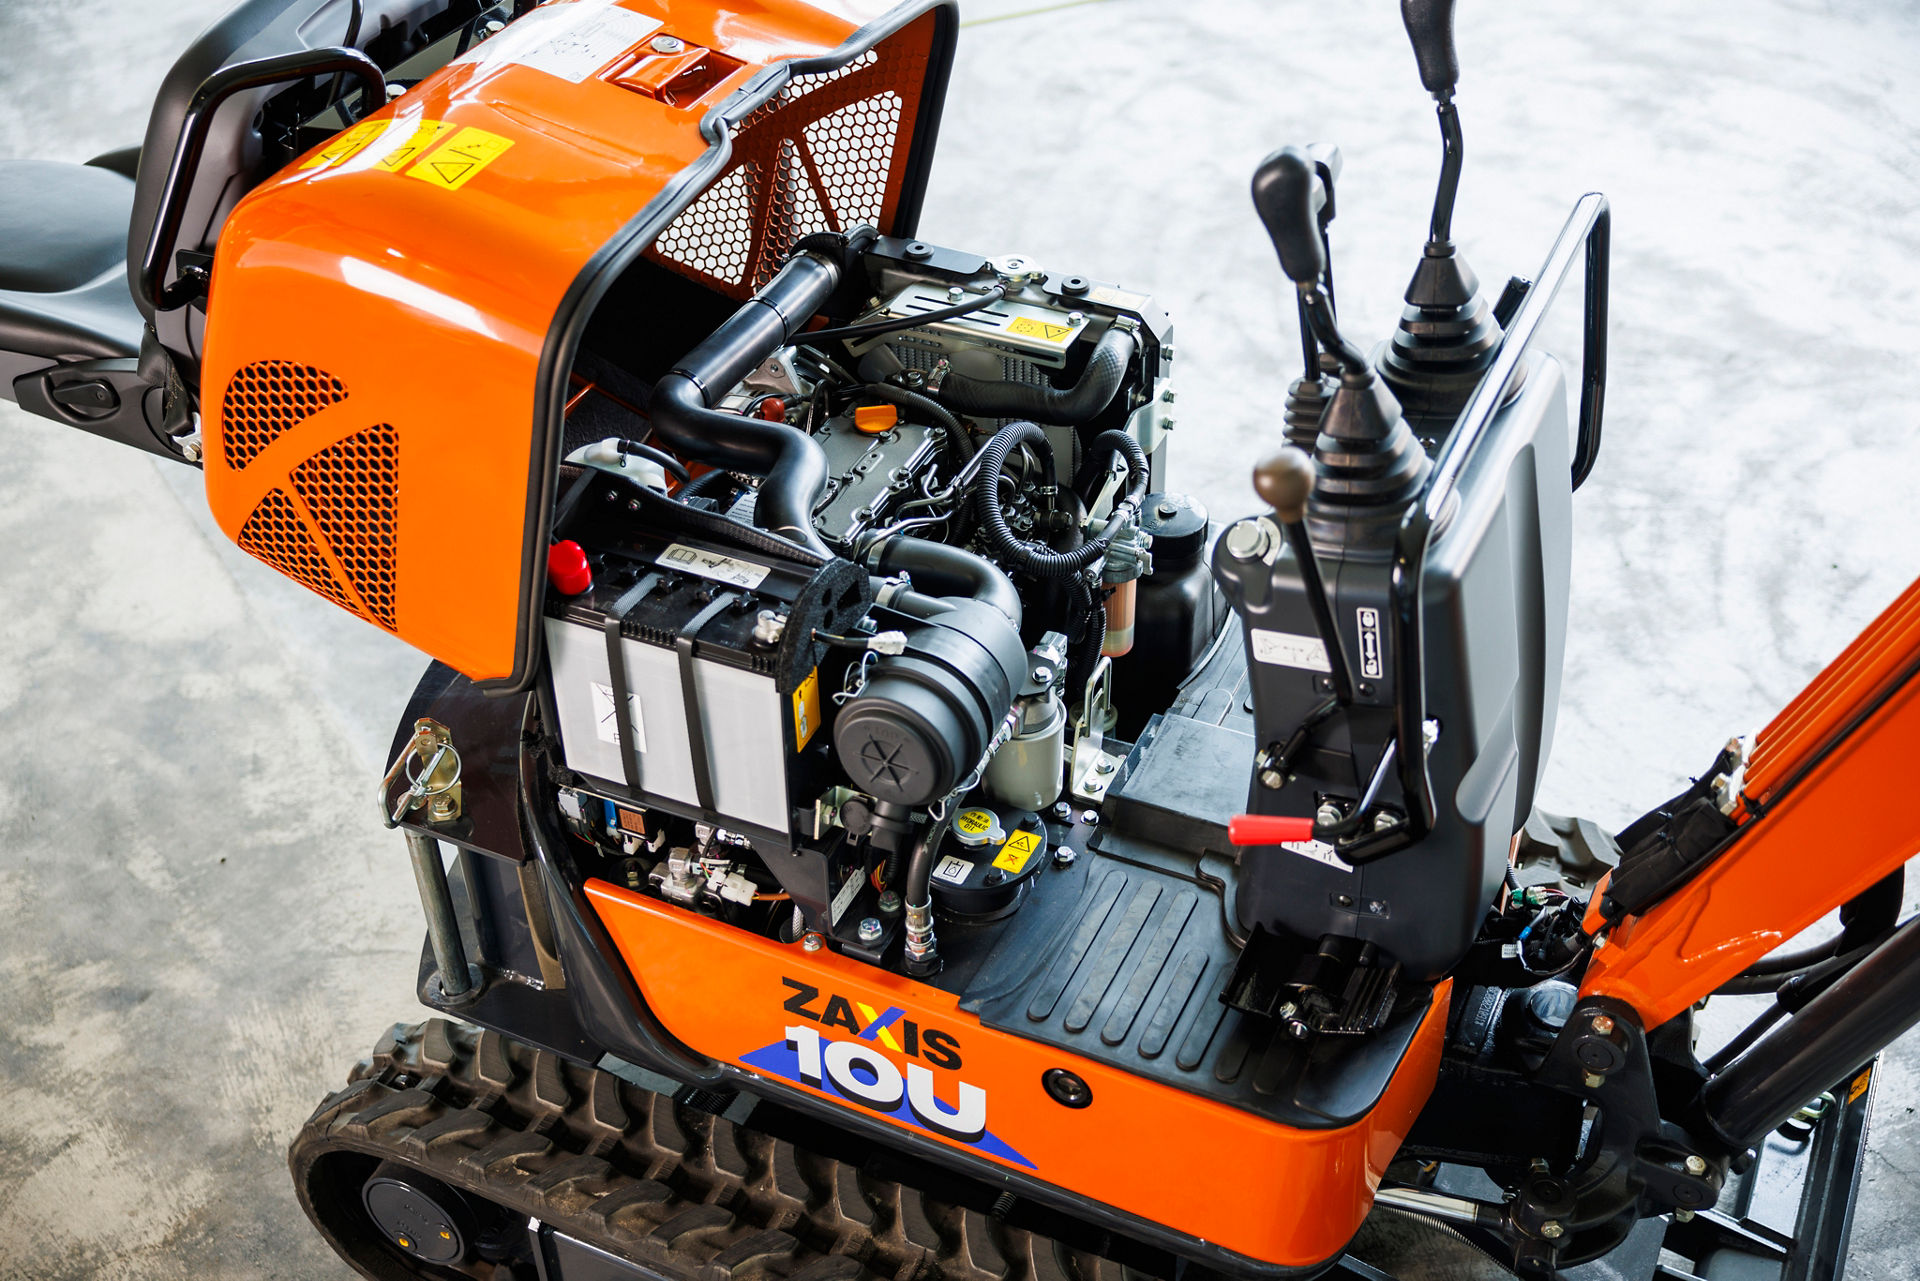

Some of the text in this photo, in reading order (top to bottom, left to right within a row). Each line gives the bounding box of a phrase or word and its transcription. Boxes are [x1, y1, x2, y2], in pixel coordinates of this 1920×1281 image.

[964, 823, 975, 831] OIL
[781, 976, 963, 1070] ZAXIS
[785, 1025, 986, 1142] 10U
